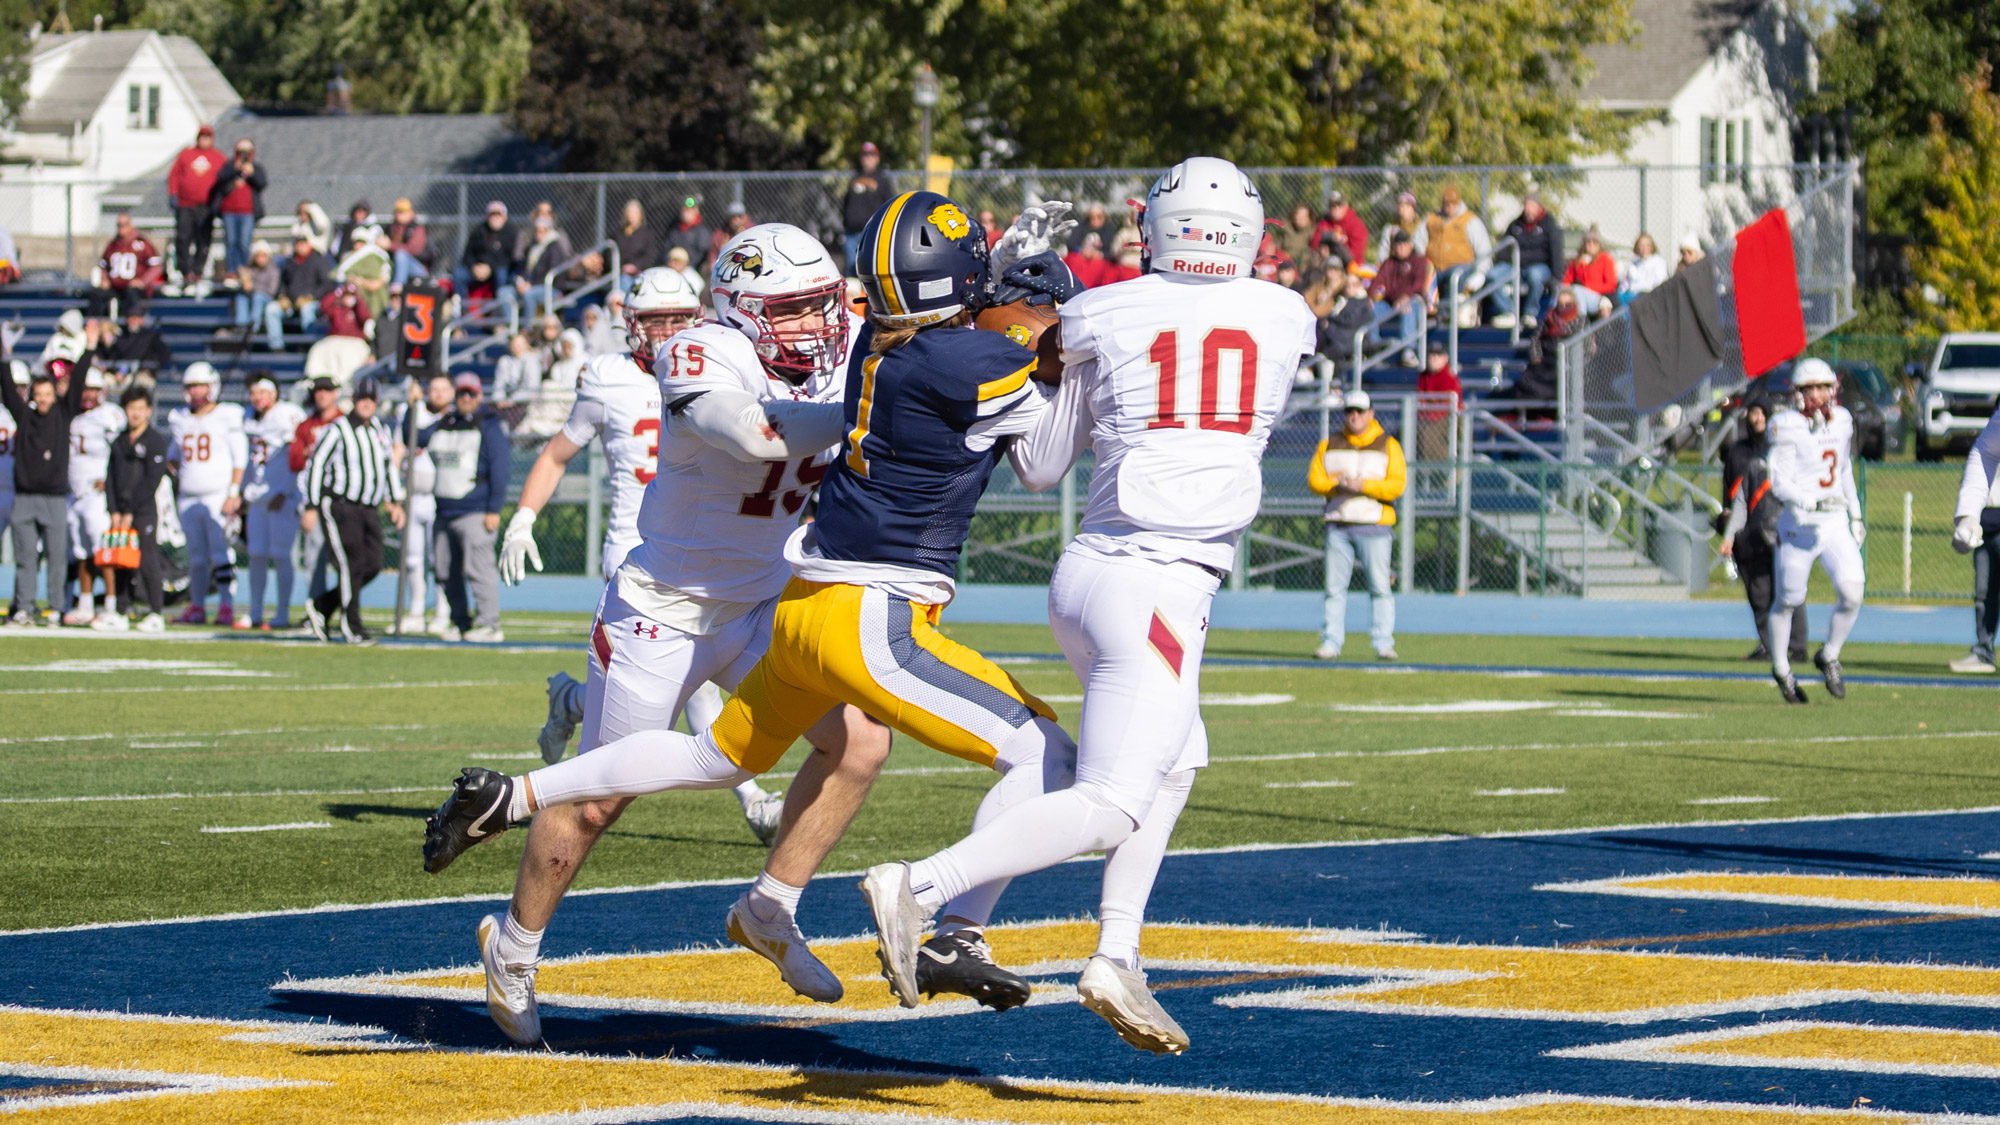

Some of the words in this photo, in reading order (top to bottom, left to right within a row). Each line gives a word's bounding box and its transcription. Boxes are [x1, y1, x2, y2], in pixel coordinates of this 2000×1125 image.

[1215, 231, 1227, 245] 10
[1173, 259, 1237, 276] Riddell
[403, 293, 435, 345] 3
[669, 342, 706, 380] 15
[1145, 325, 1261, 436] 10
[846, 353, 885, 480] 1
[182, 433, 211, 462] 58
[1819, 449, 1838, 489] 3
